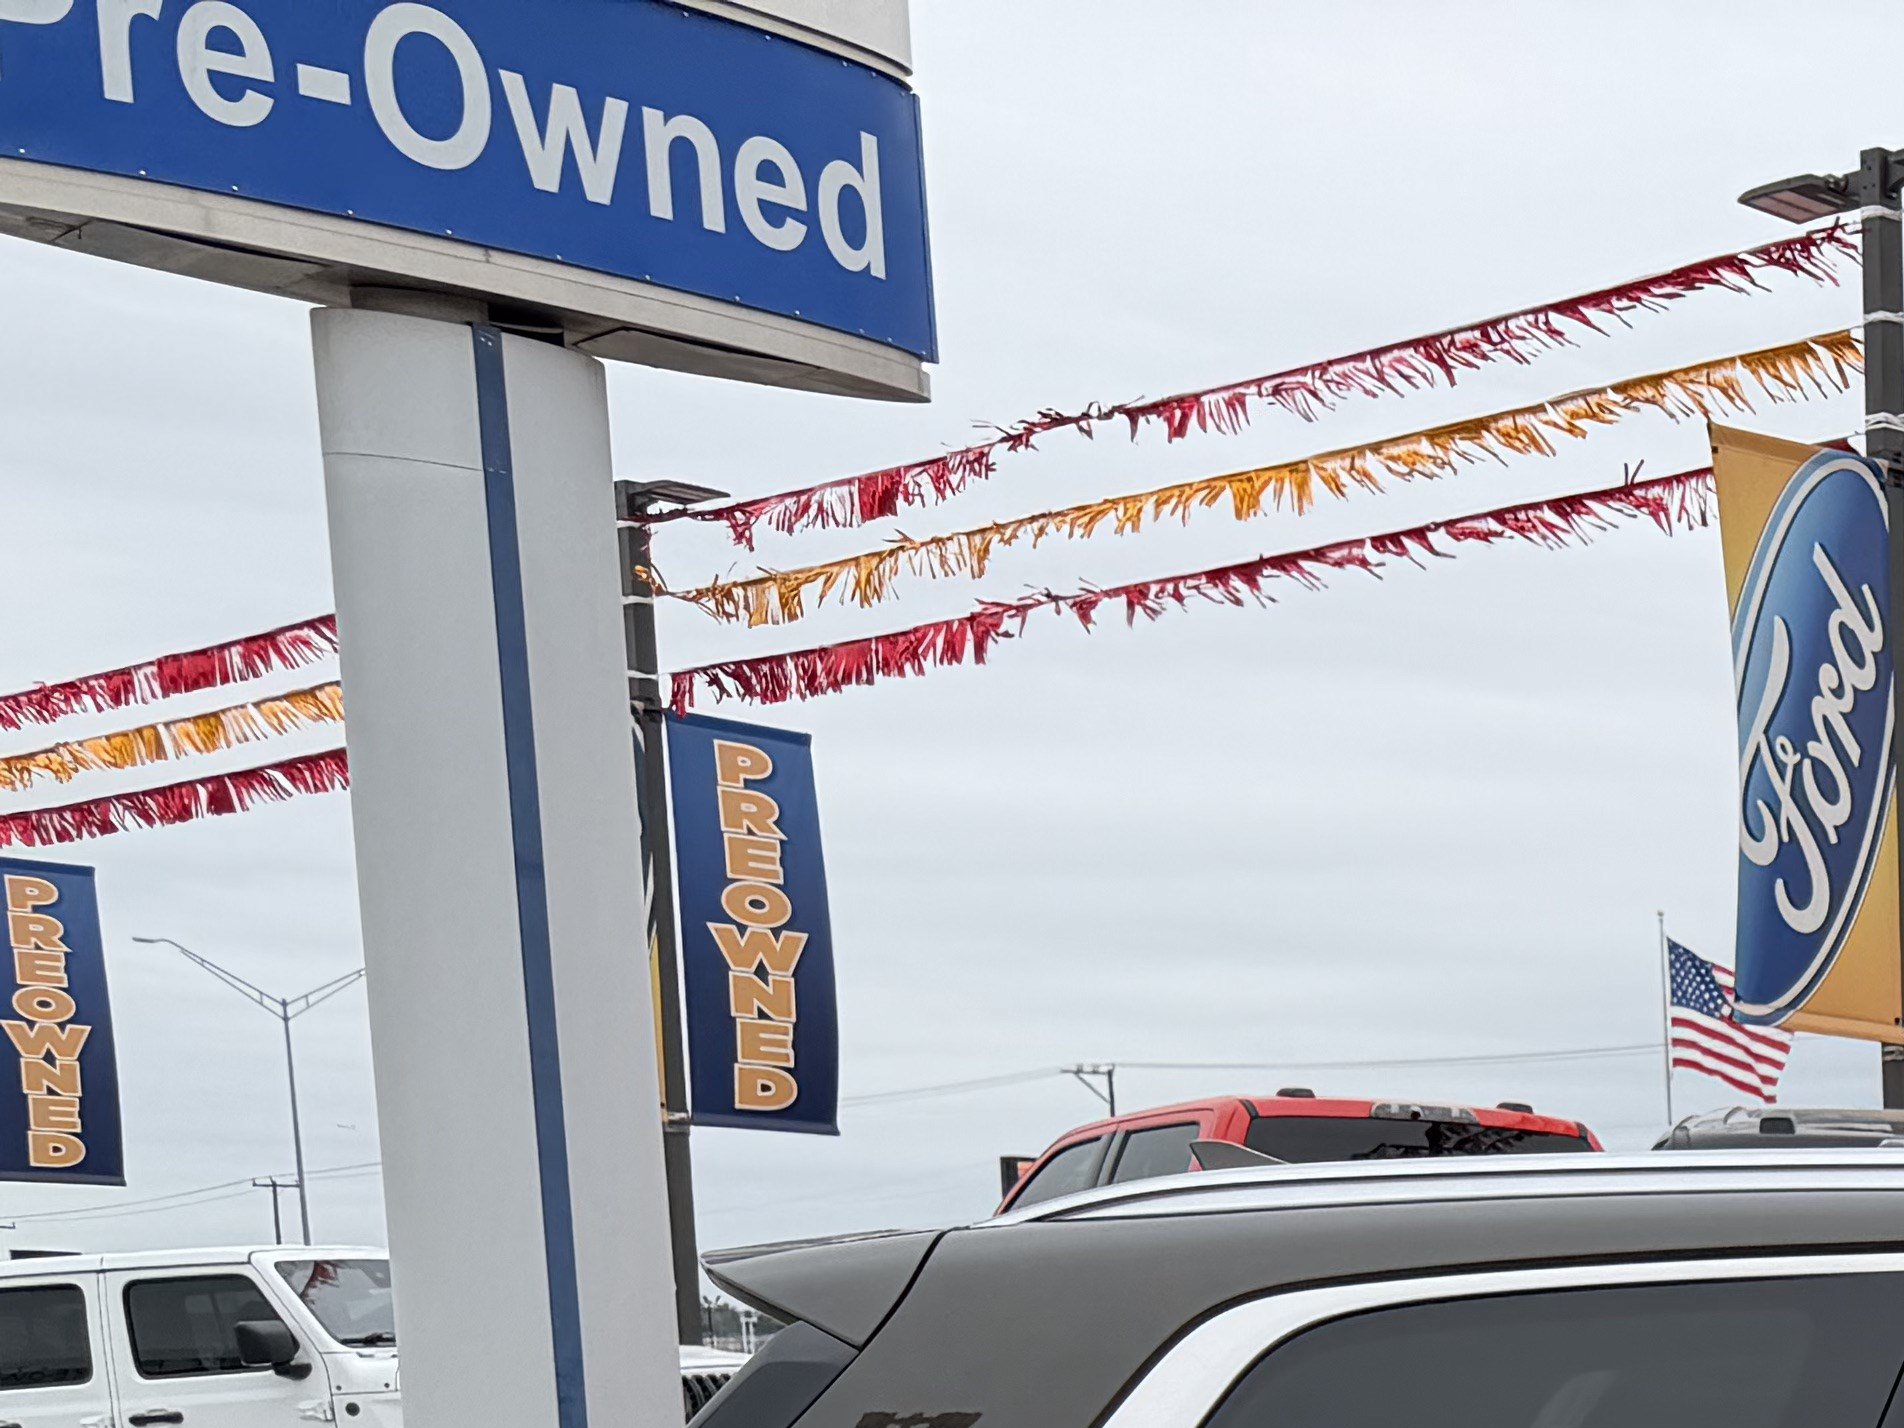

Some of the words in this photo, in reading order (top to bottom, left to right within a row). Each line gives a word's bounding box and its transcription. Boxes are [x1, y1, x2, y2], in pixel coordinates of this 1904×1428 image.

[0, 0, 888, 280] re-Owned
[1740, 542, 1884, 935] Ford
[2, 874, 92, 1168] PREOWNED
[706, 738, 809, 1112] PREOWNED
